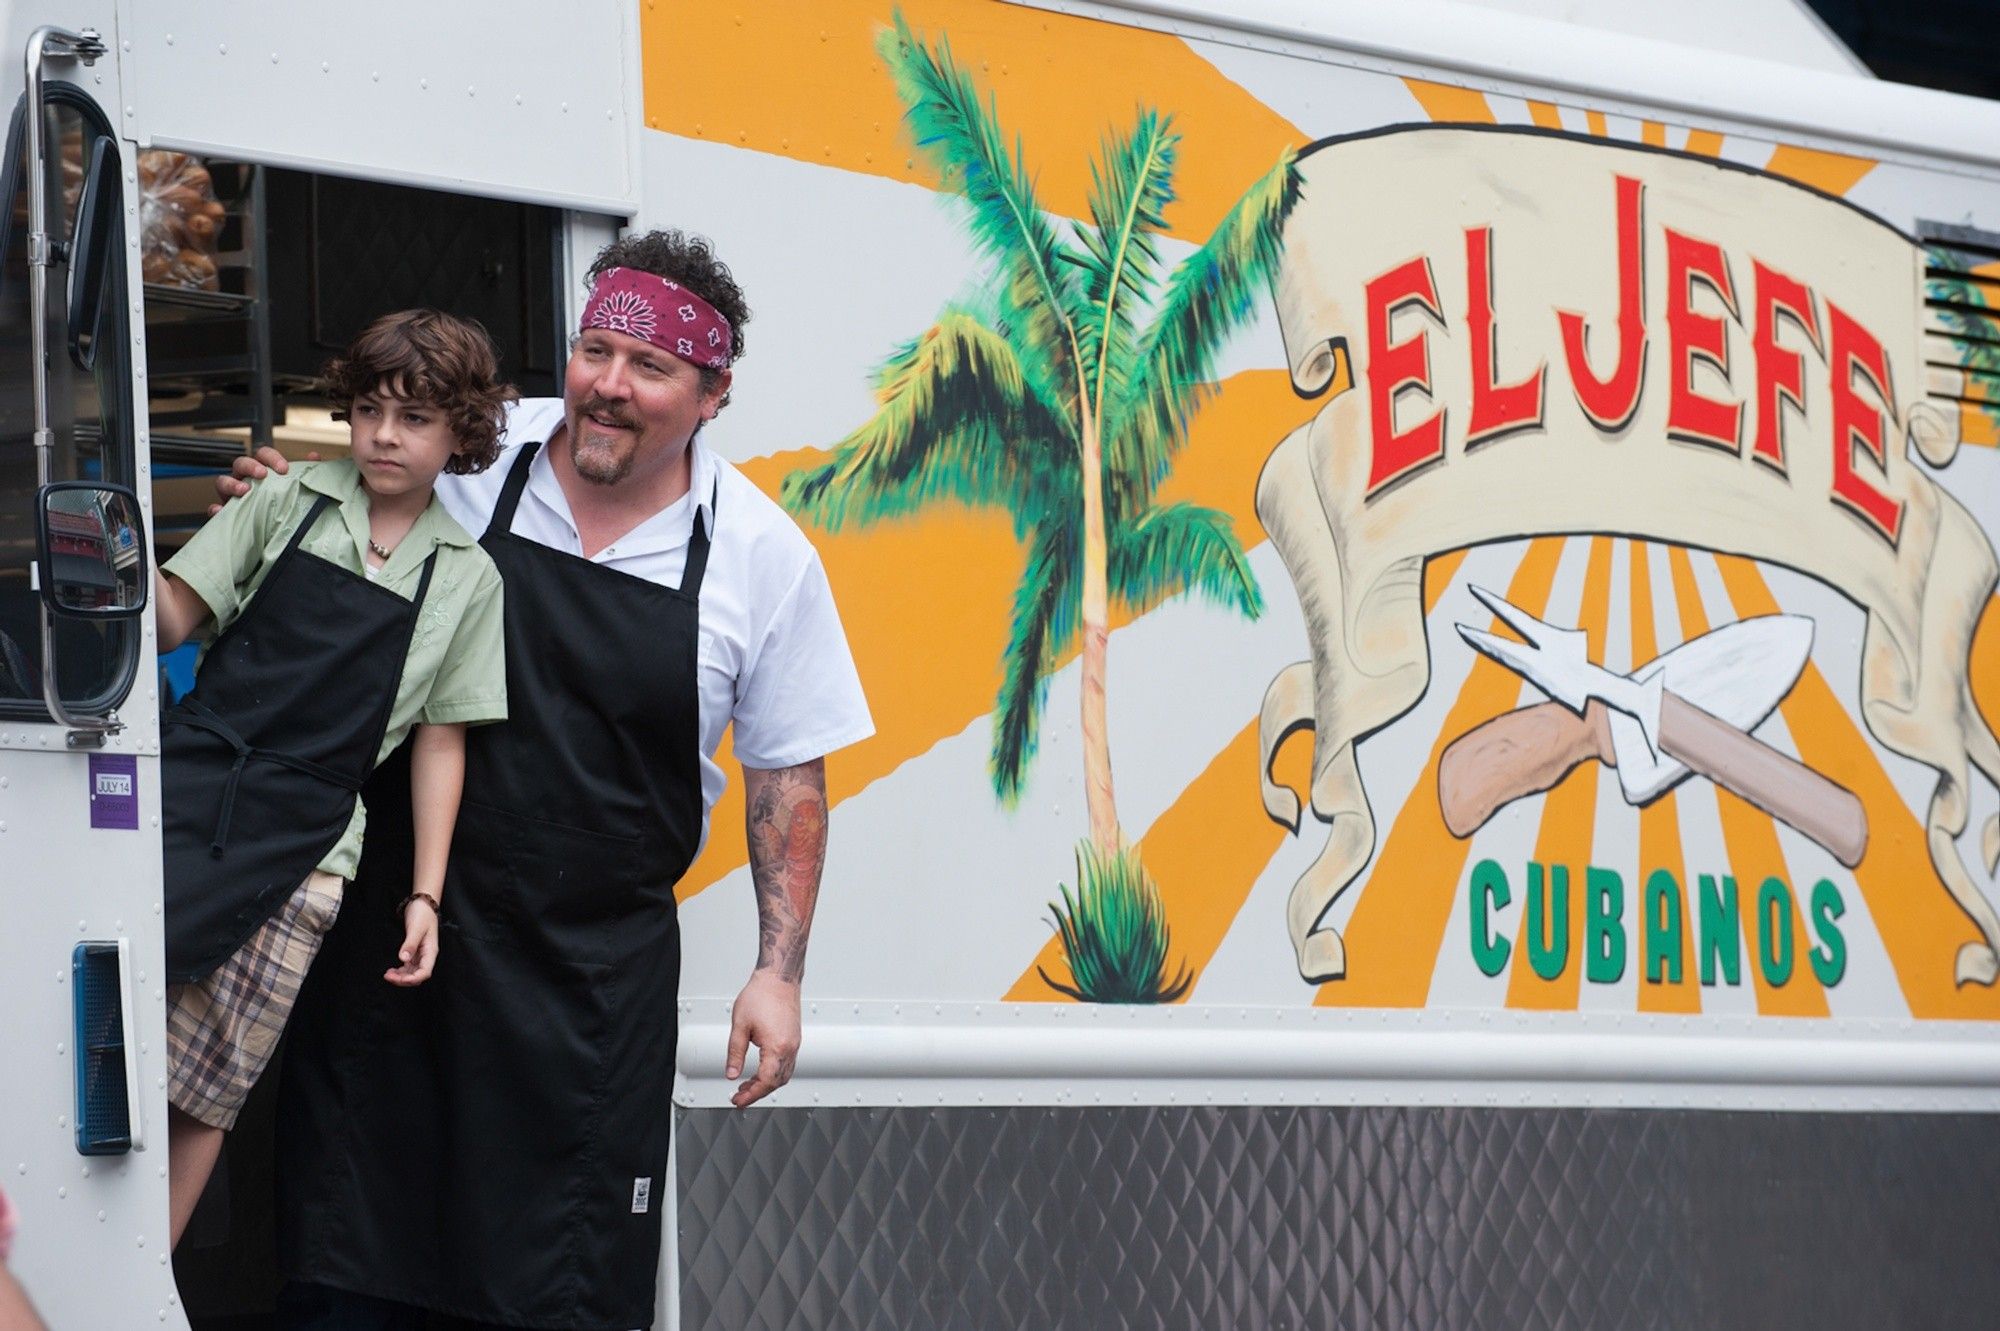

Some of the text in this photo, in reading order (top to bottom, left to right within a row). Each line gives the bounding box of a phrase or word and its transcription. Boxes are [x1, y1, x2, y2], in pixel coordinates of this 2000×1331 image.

[1364, 172, 1906, 553] EL JEFE
[98, 781, 129, 792] JULY 14
[1469, 858, 1847, 988] CUBANOS
